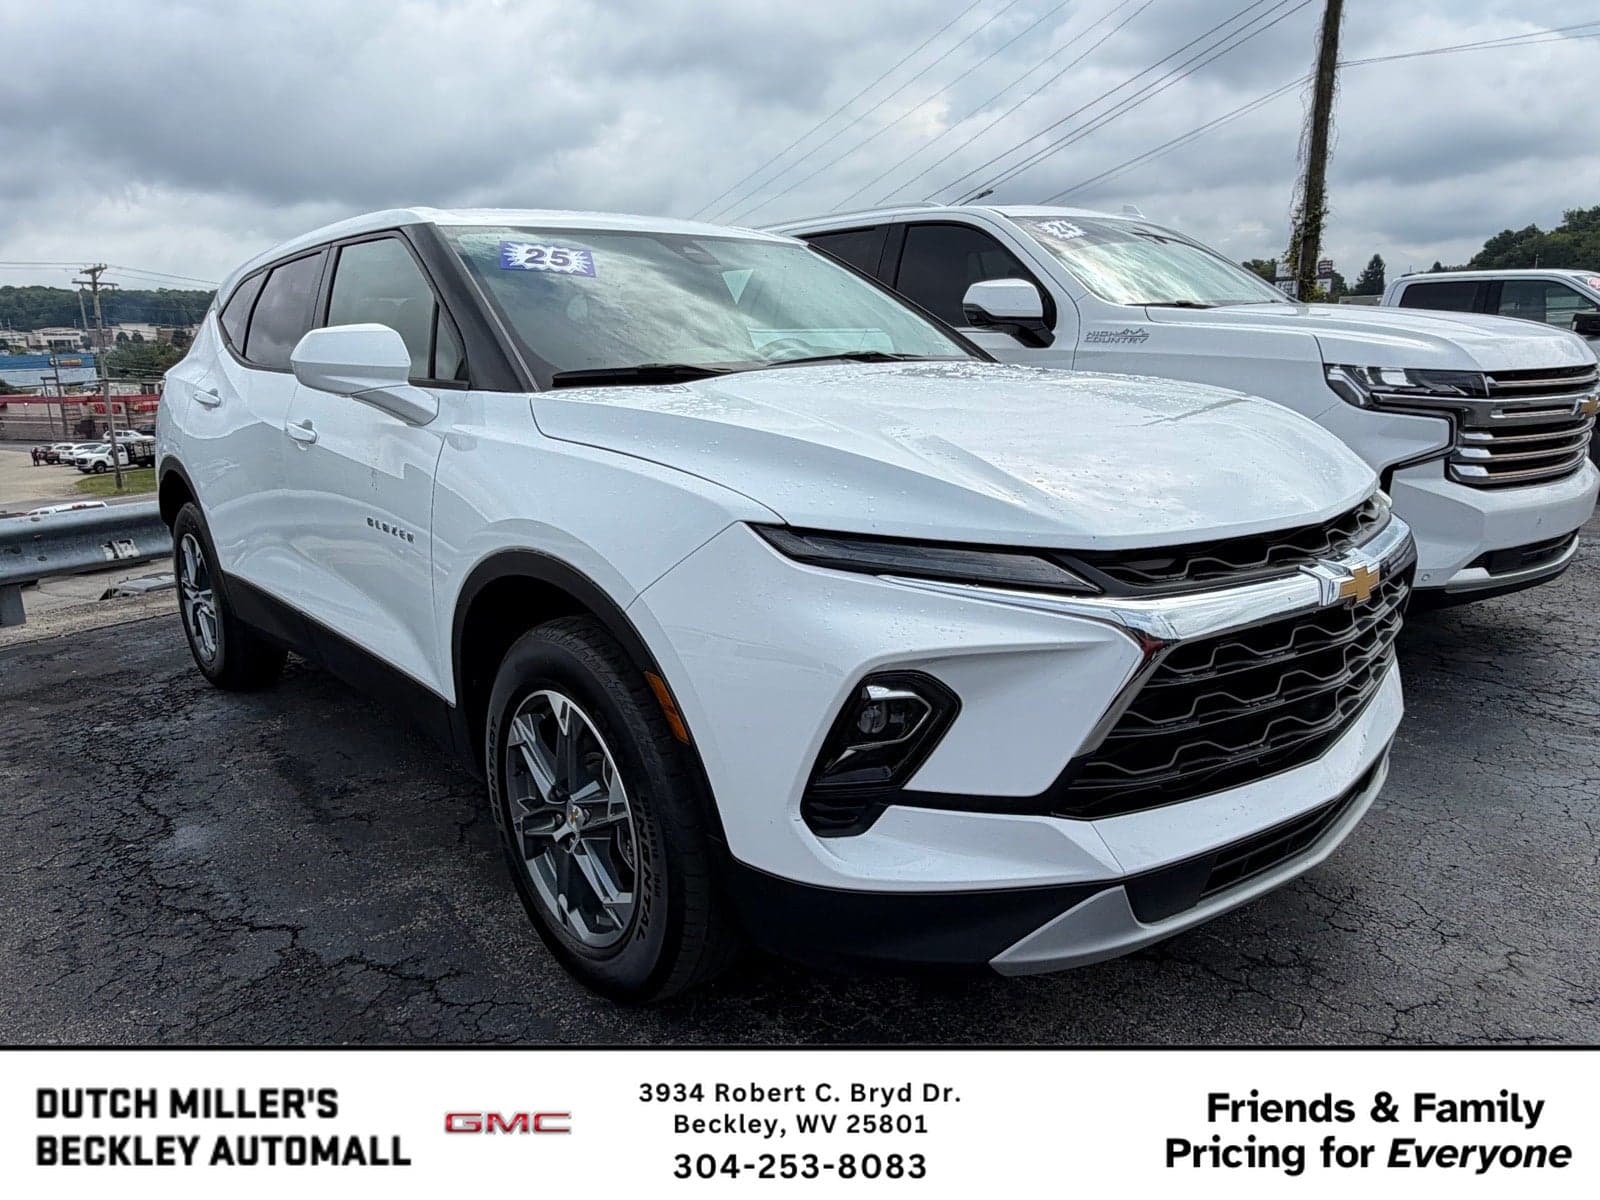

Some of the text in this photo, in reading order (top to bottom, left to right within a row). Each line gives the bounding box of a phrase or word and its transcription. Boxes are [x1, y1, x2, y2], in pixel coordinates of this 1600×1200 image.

[514, 248, 572, 266] 25
[1084, 335, 1149, 344] COUNTRY
[366, 516, 415, 544] BLAZER
